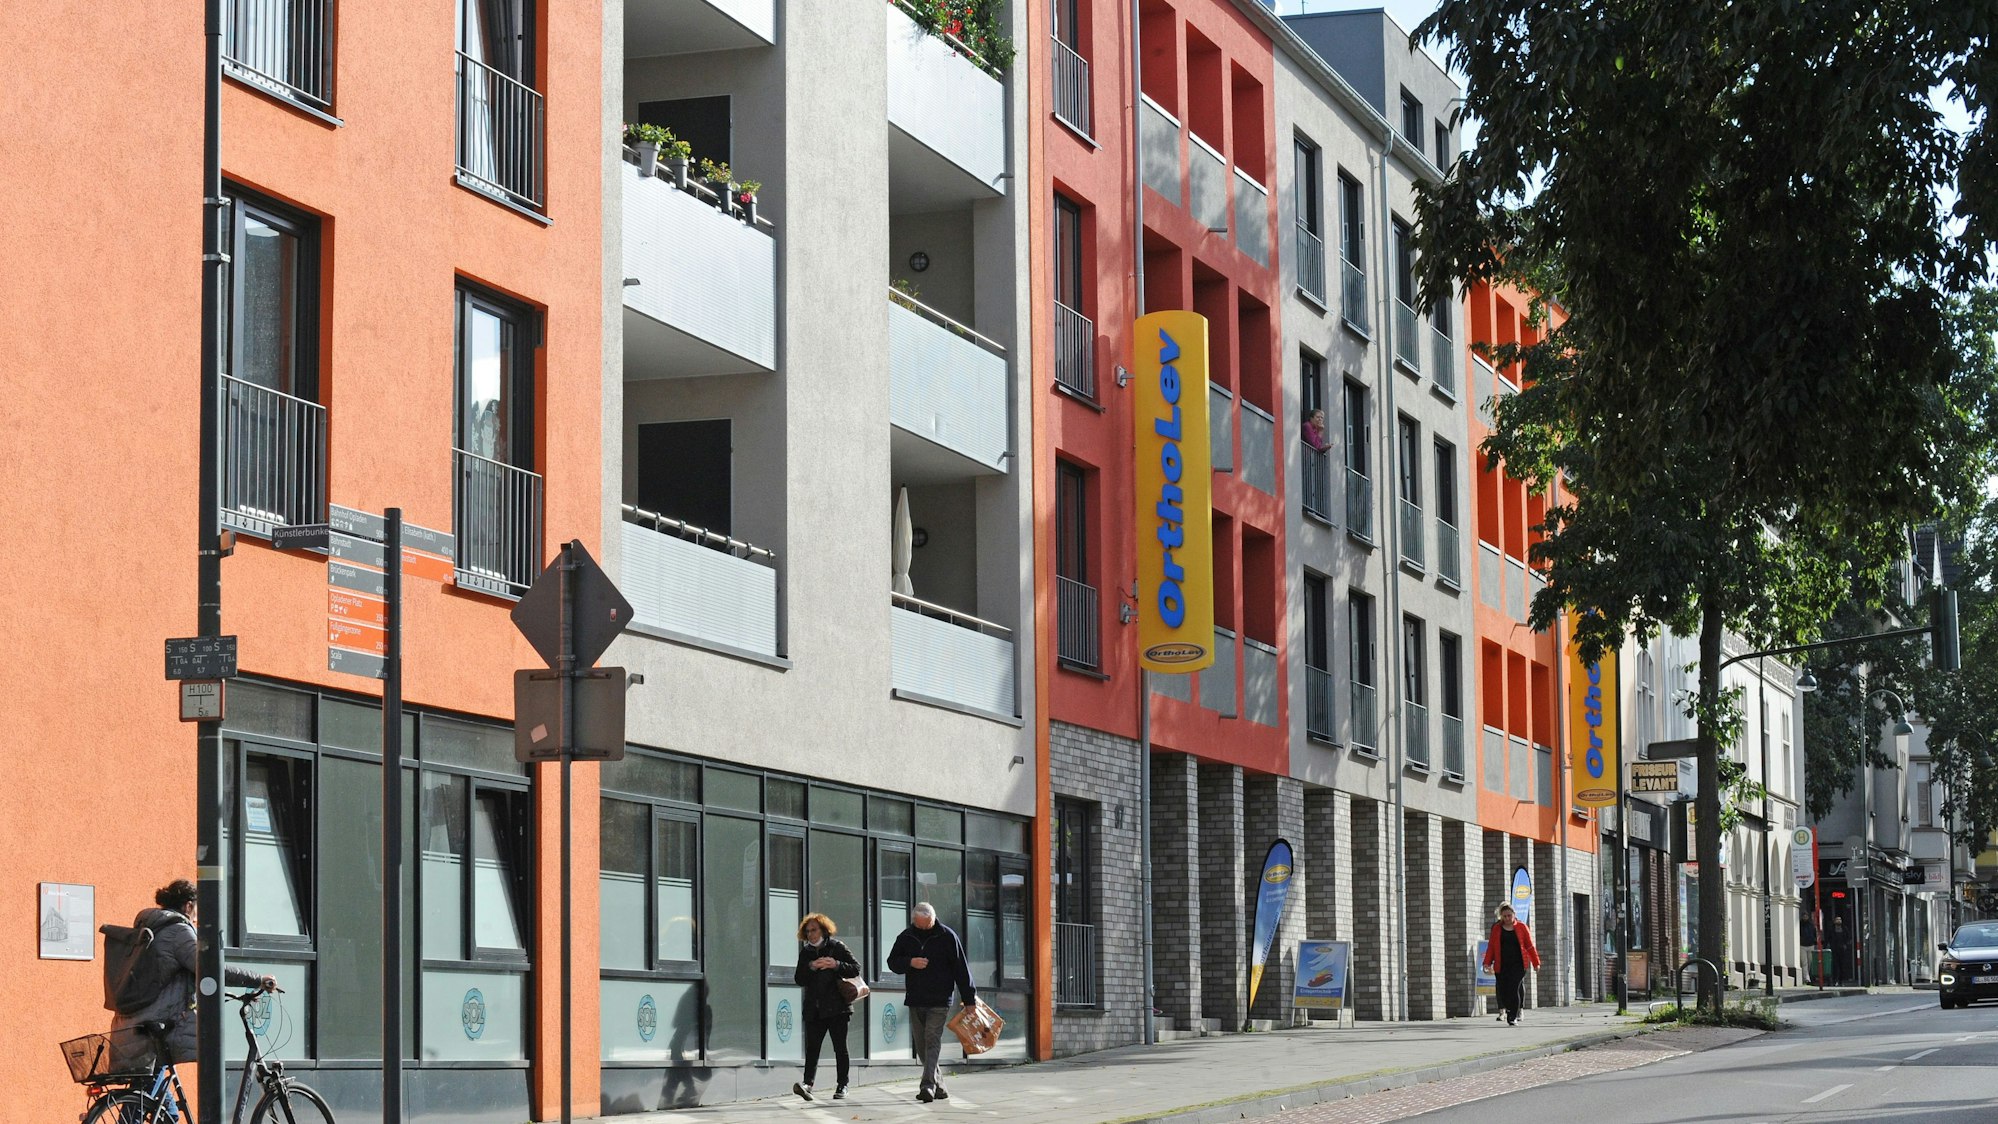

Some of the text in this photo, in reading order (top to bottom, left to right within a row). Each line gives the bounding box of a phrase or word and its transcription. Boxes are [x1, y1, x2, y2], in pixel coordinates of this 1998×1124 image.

[1155, 327, 1184, 629] OrthoLev
[331, 507, 367, 523] Bahnhof Opladen
[274, 527, 329, 538] Künstlerbunke
[331, 564, 357, 578] Brückenpark
[166, 644, 172, 654] S
[189, 643, 196, 653] S
[213, 642, 220, 651] S
[331, 650, 342, 660] Scala
[1149, 649, 1201, 657] OrthoLev
[1584, 661, 1604, 778] Ortho
[1632, 763, 1676, 776] FRISEUR
[1632, 777, 1676, 790] LEVANT
[1798, 833, 1806, 842] H
[1905, 870, 1922, 880] sky
